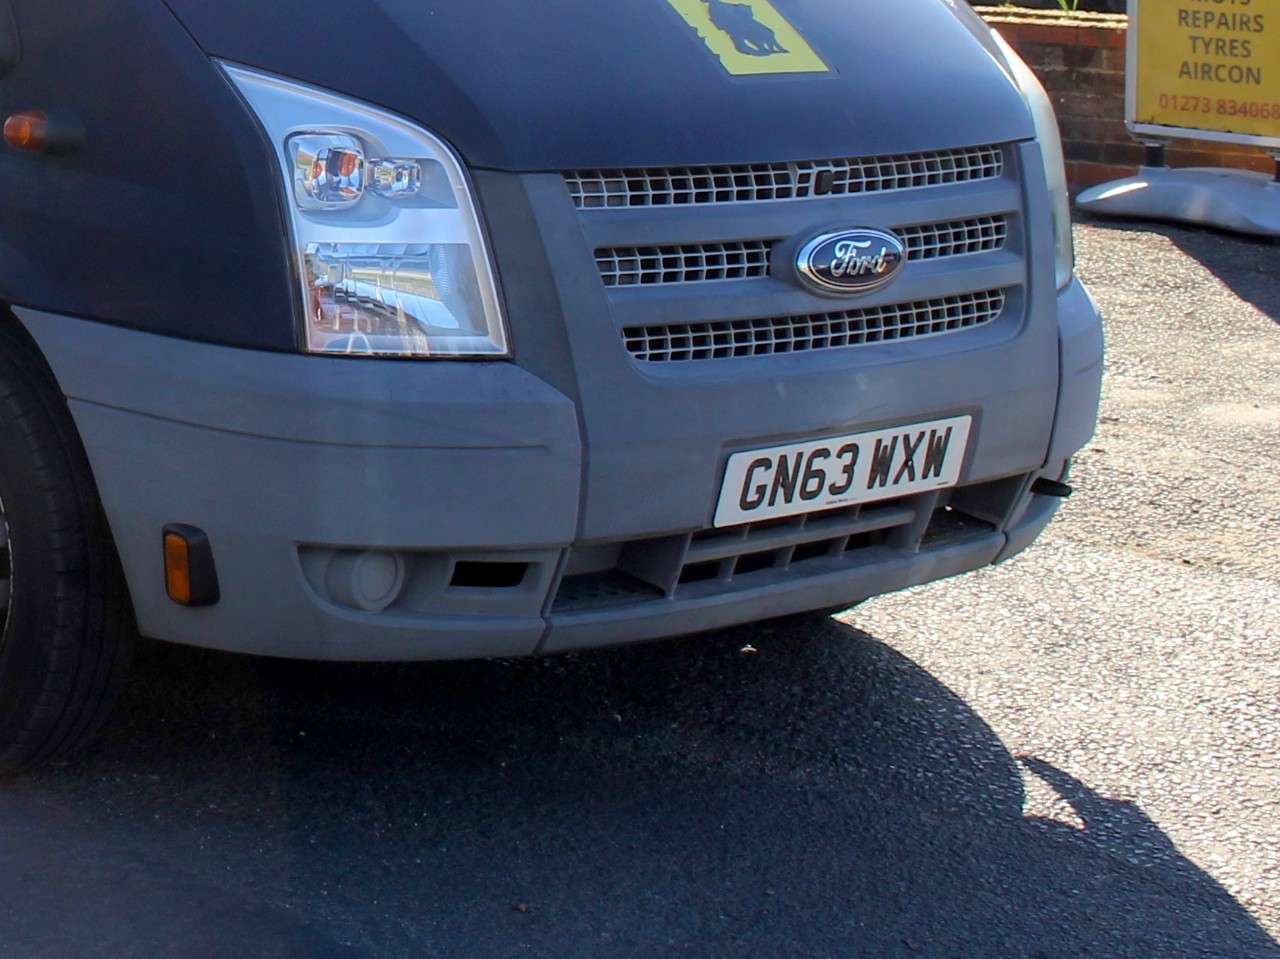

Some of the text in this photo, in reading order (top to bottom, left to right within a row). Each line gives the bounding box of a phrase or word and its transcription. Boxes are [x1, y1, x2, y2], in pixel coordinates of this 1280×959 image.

[1177, 8, 1265, 33] REPAIRS
[1188, 35, 1252, 59] TYRES
[1177, 60, 1262, 85] AIRCON
[1158, 93, 1280, 121] 01273 834068
[830, 240, 887, 278] Ford
[738, 426, 953, 512] GN63 WXW
